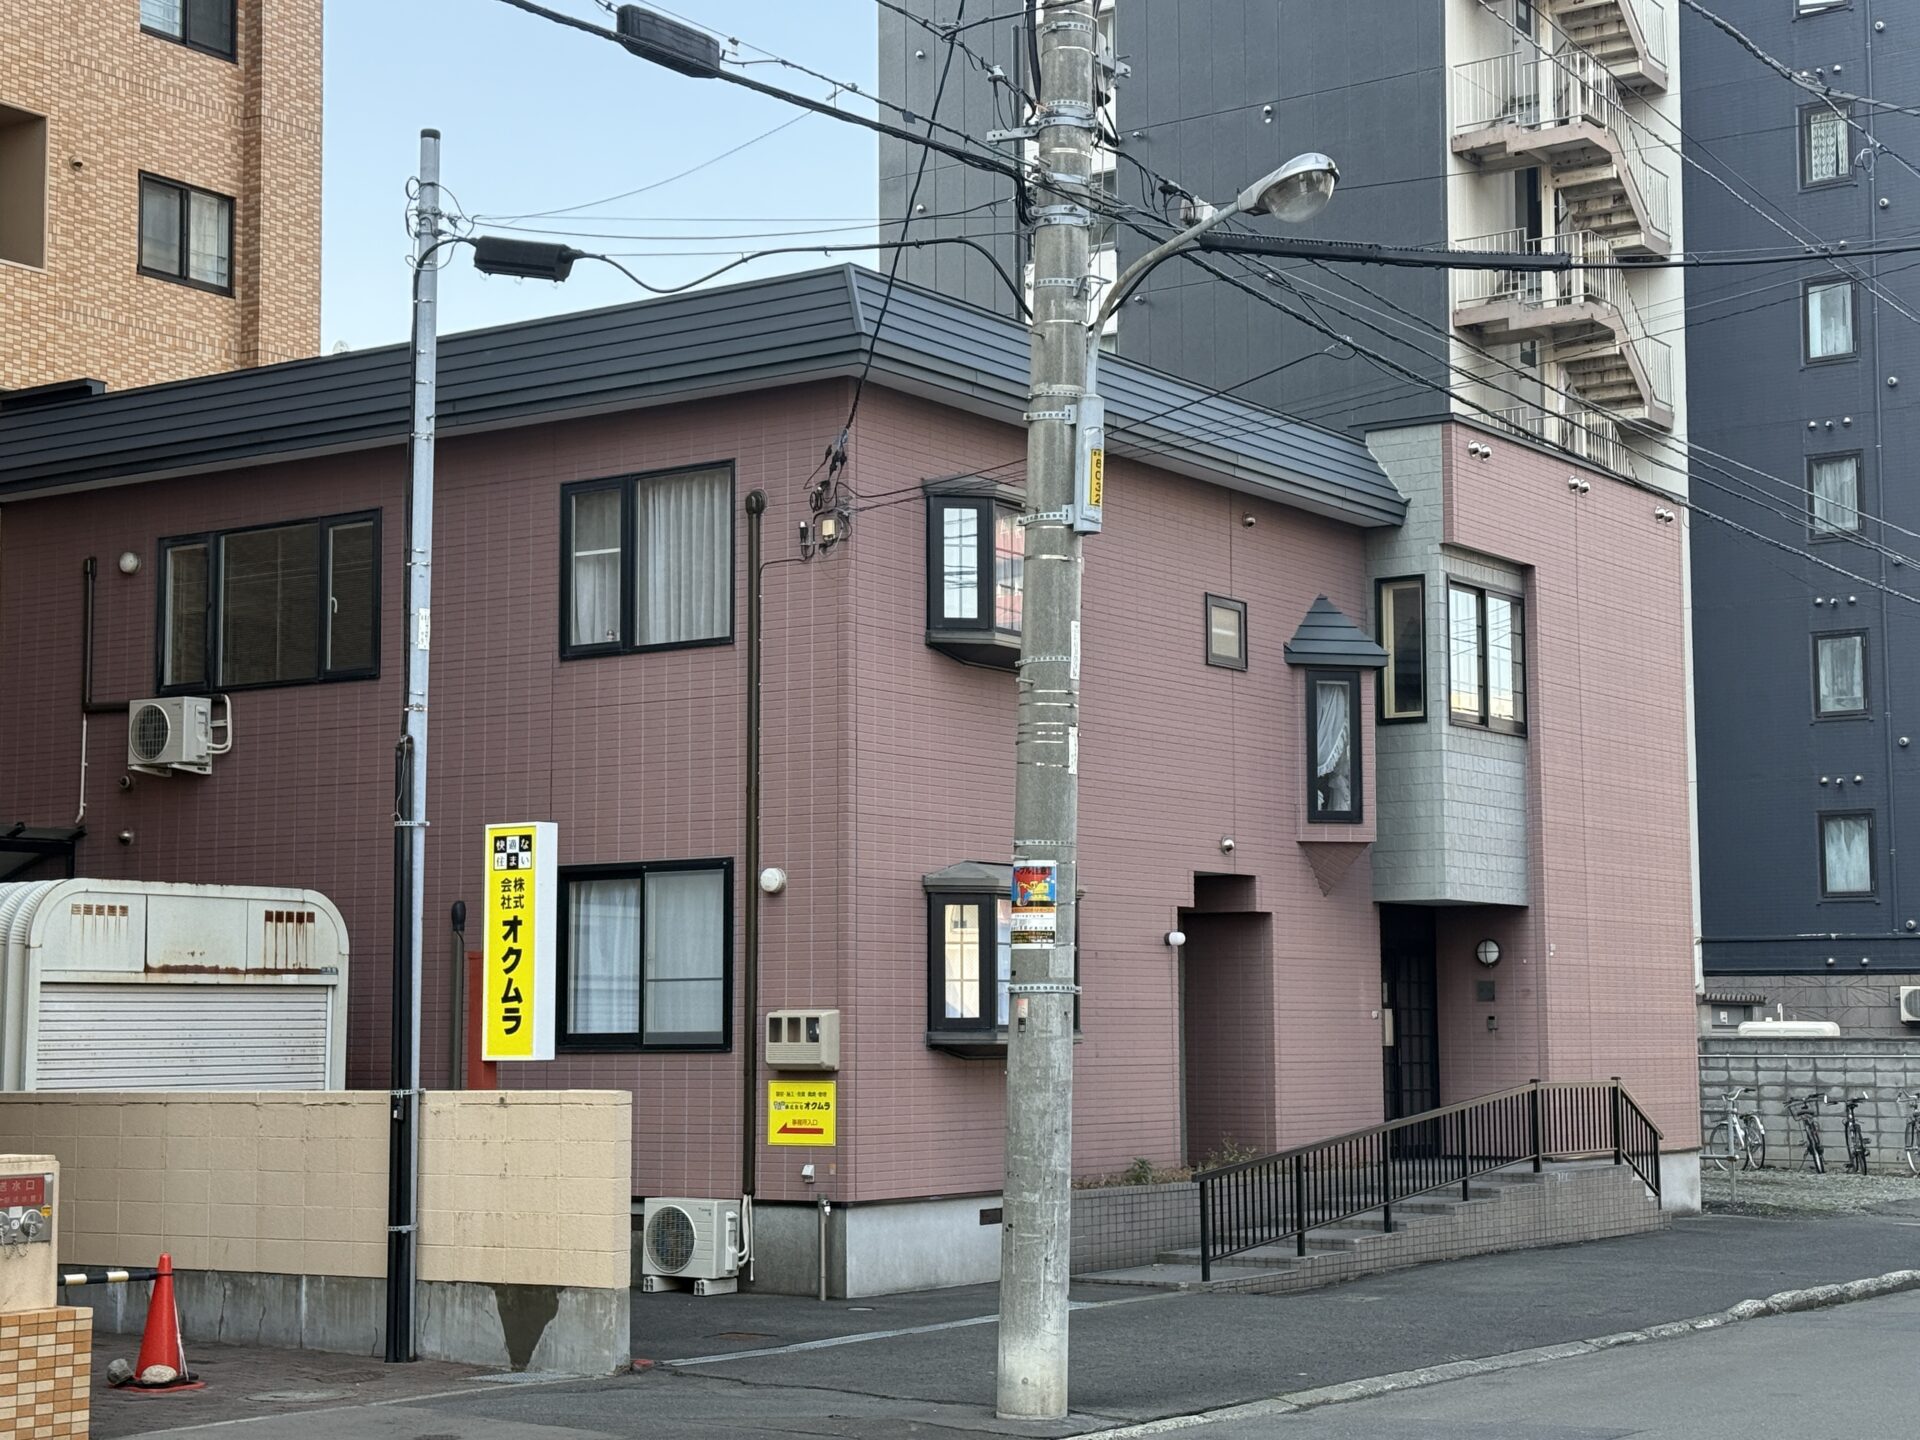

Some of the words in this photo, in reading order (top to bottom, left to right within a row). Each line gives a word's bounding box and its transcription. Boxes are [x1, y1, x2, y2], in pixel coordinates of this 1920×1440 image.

[496, 855, 530, 867] 住まい
[501, 915, 523, 1035] オクムラ
